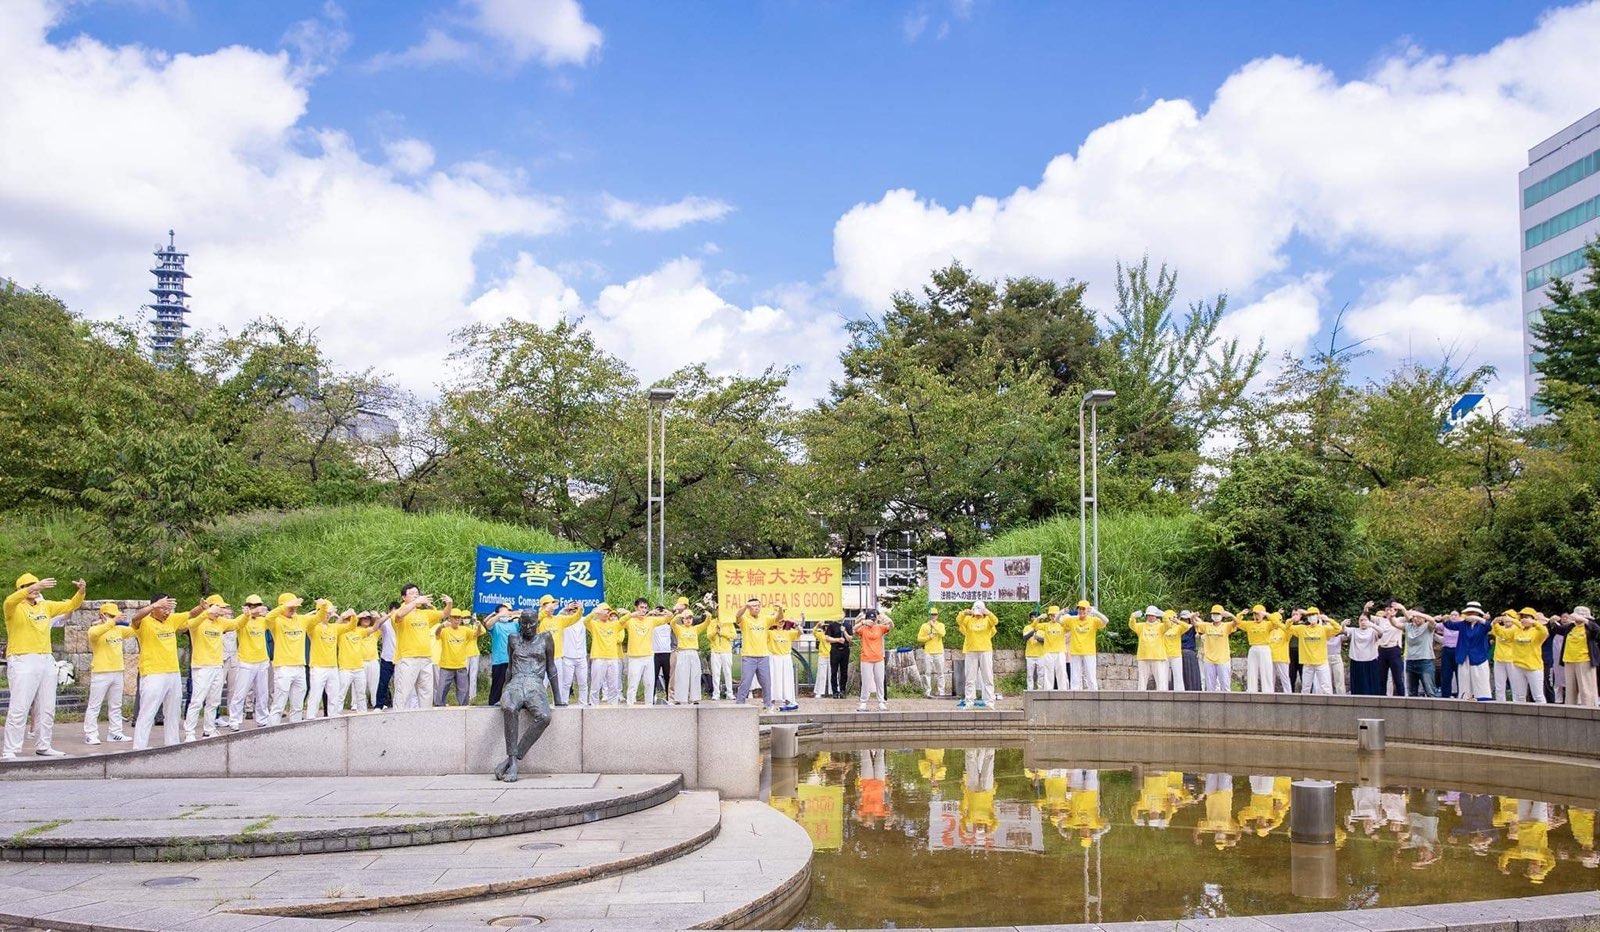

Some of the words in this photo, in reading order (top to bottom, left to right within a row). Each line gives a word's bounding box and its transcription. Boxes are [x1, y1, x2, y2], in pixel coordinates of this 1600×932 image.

[482, 556, 598, 588] 真善忍
[725, 566, 833, 587] 法輪大法好
[940, 559, 995, 589] SOS
[791, 592, 800, 608] IS
[803, 591, 834, 608] GOOD
